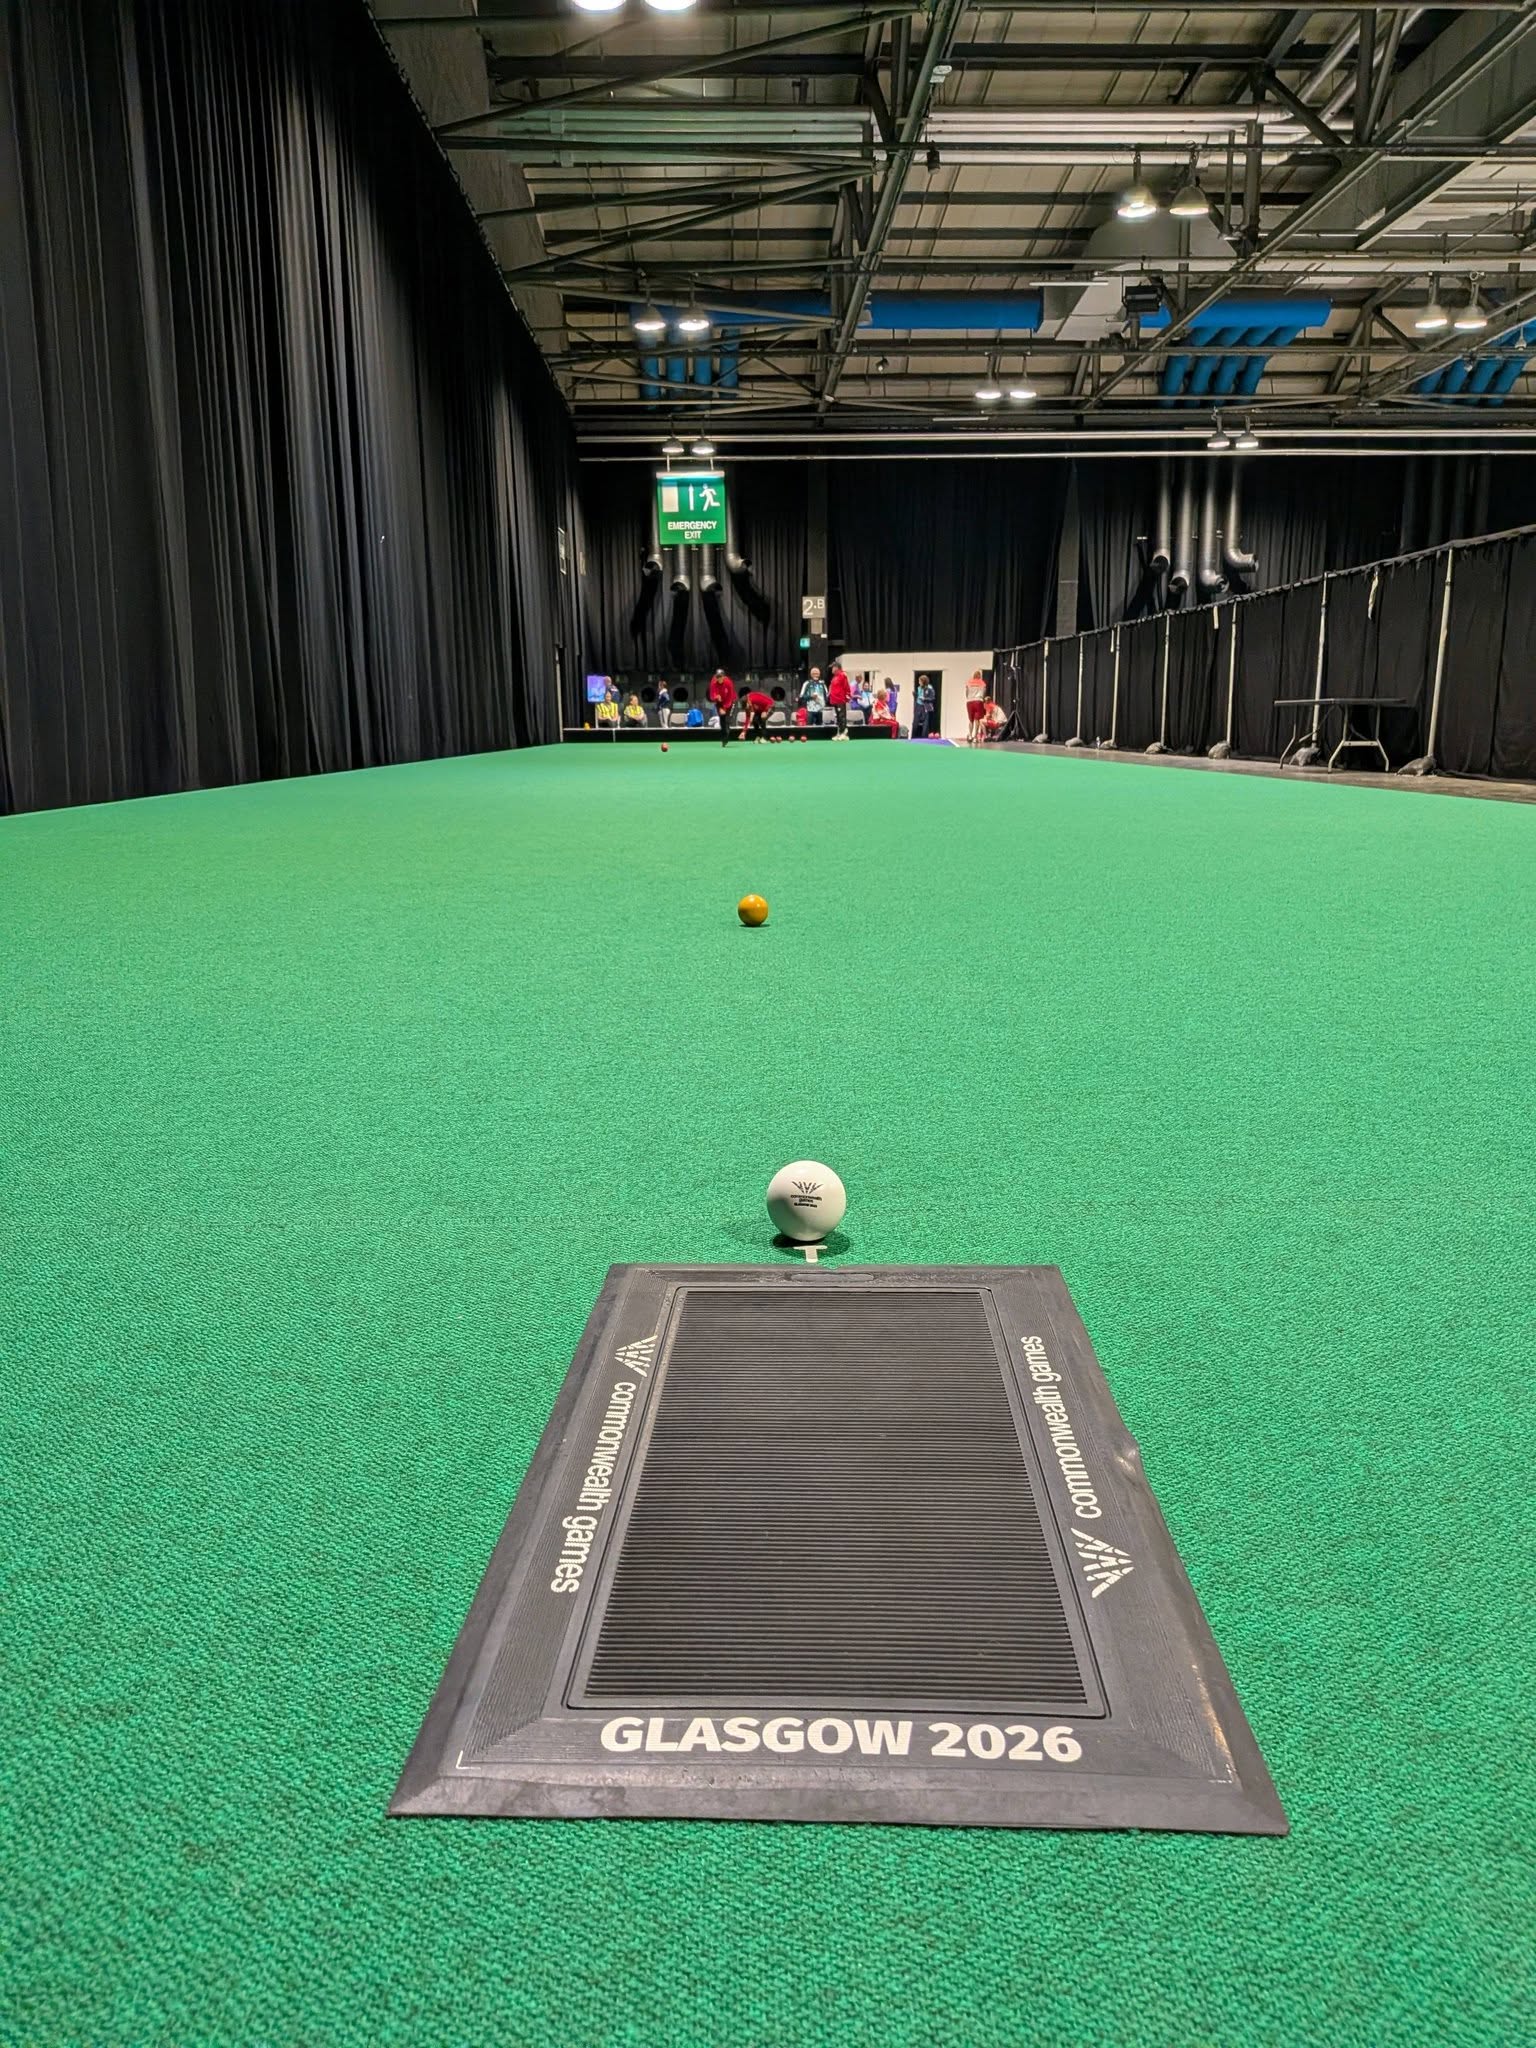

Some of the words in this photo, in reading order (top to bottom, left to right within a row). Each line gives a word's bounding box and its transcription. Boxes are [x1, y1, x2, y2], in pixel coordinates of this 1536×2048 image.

[667, 520, 717, 530] EMERGENCY
[684, 530, 702, 540] EXIT
[1020, 1335, 1062, 1383] games
[576, 1381, 637, 1512] commonwealth
[1032, 1385, 1103, 1520] commonwealth
[550, 1515, 598, 1594] games
[600, 1716, 913, 1756] GLASGOW
[927, 1721, 1083, 1763] 2026
